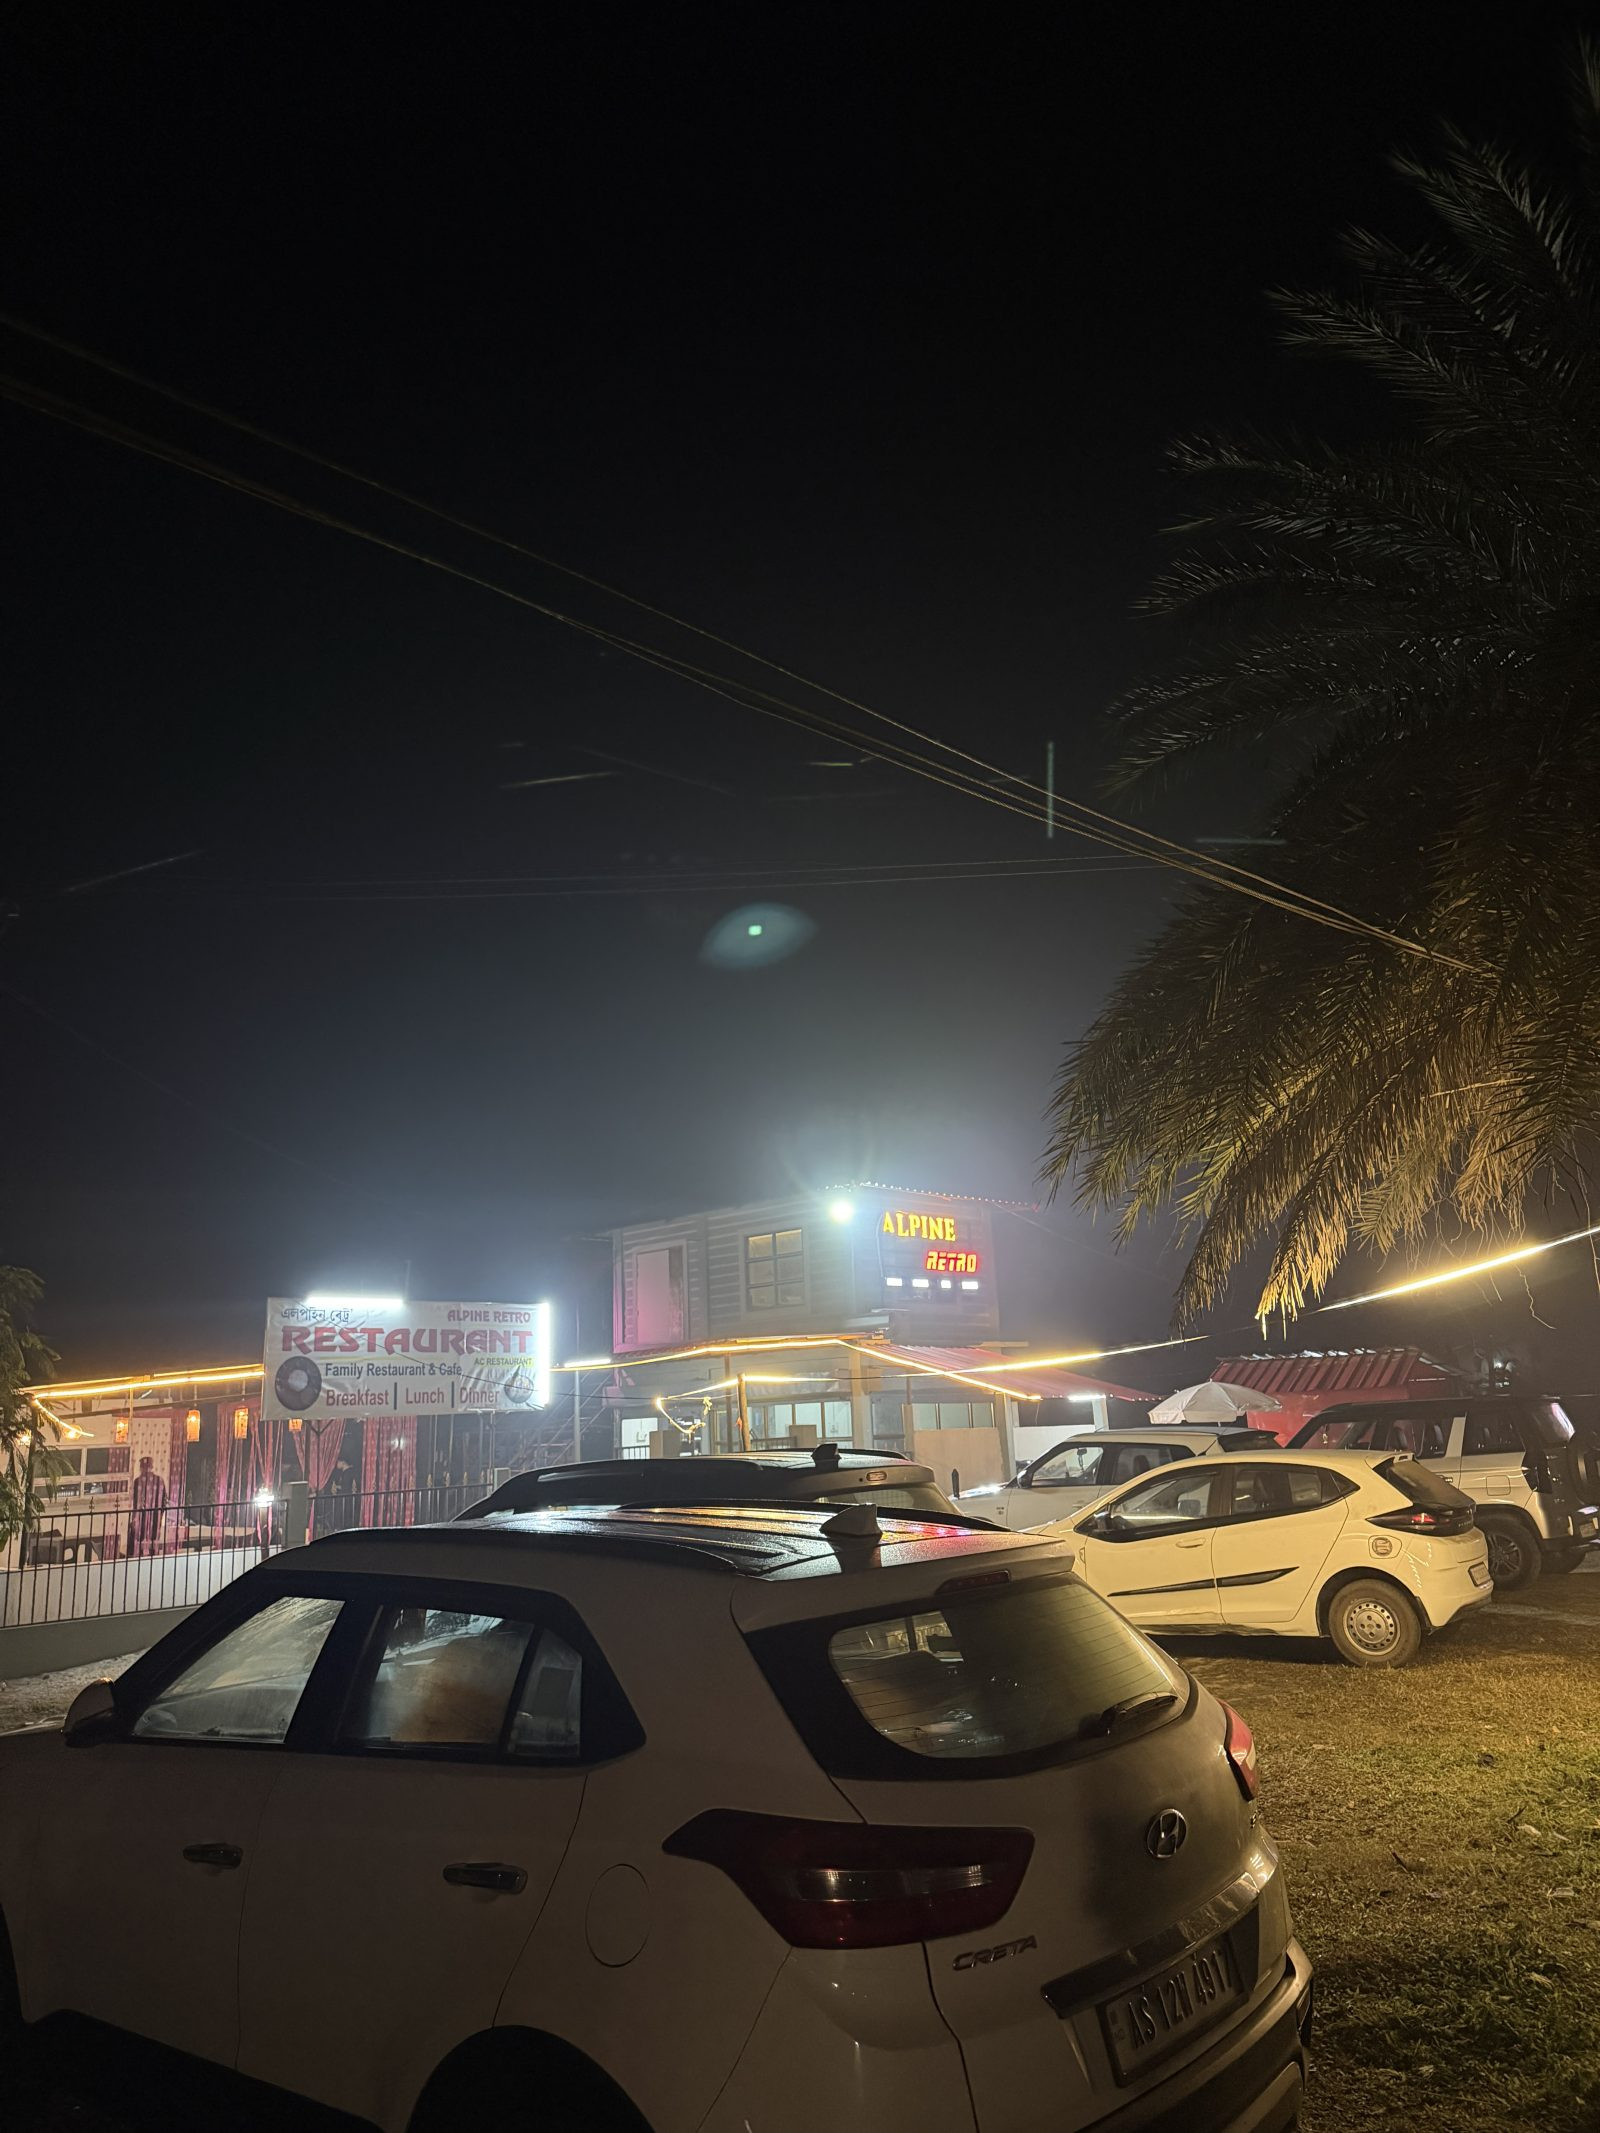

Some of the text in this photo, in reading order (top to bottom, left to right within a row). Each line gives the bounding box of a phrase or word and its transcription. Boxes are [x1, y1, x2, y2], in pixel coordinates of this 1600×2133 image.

[883, 1212, 956, 1241] ALPINE
[926, 1251, 977, 1273] RETRO
[447, 1309, 532, 1323] ALPINE RETRO
[281, 1326, 533, 1355] RESTAURANT
[325, 1362, 363, 1378] Family
[366, 1361, 426, 1377] Restaurant
[474, 1357, 533, 1367] AC RESTAURANT
[326, 1387, 500, 1407] Breakfast Lunch Dinner
[952, 1935, 1038, 1971] CRETA
